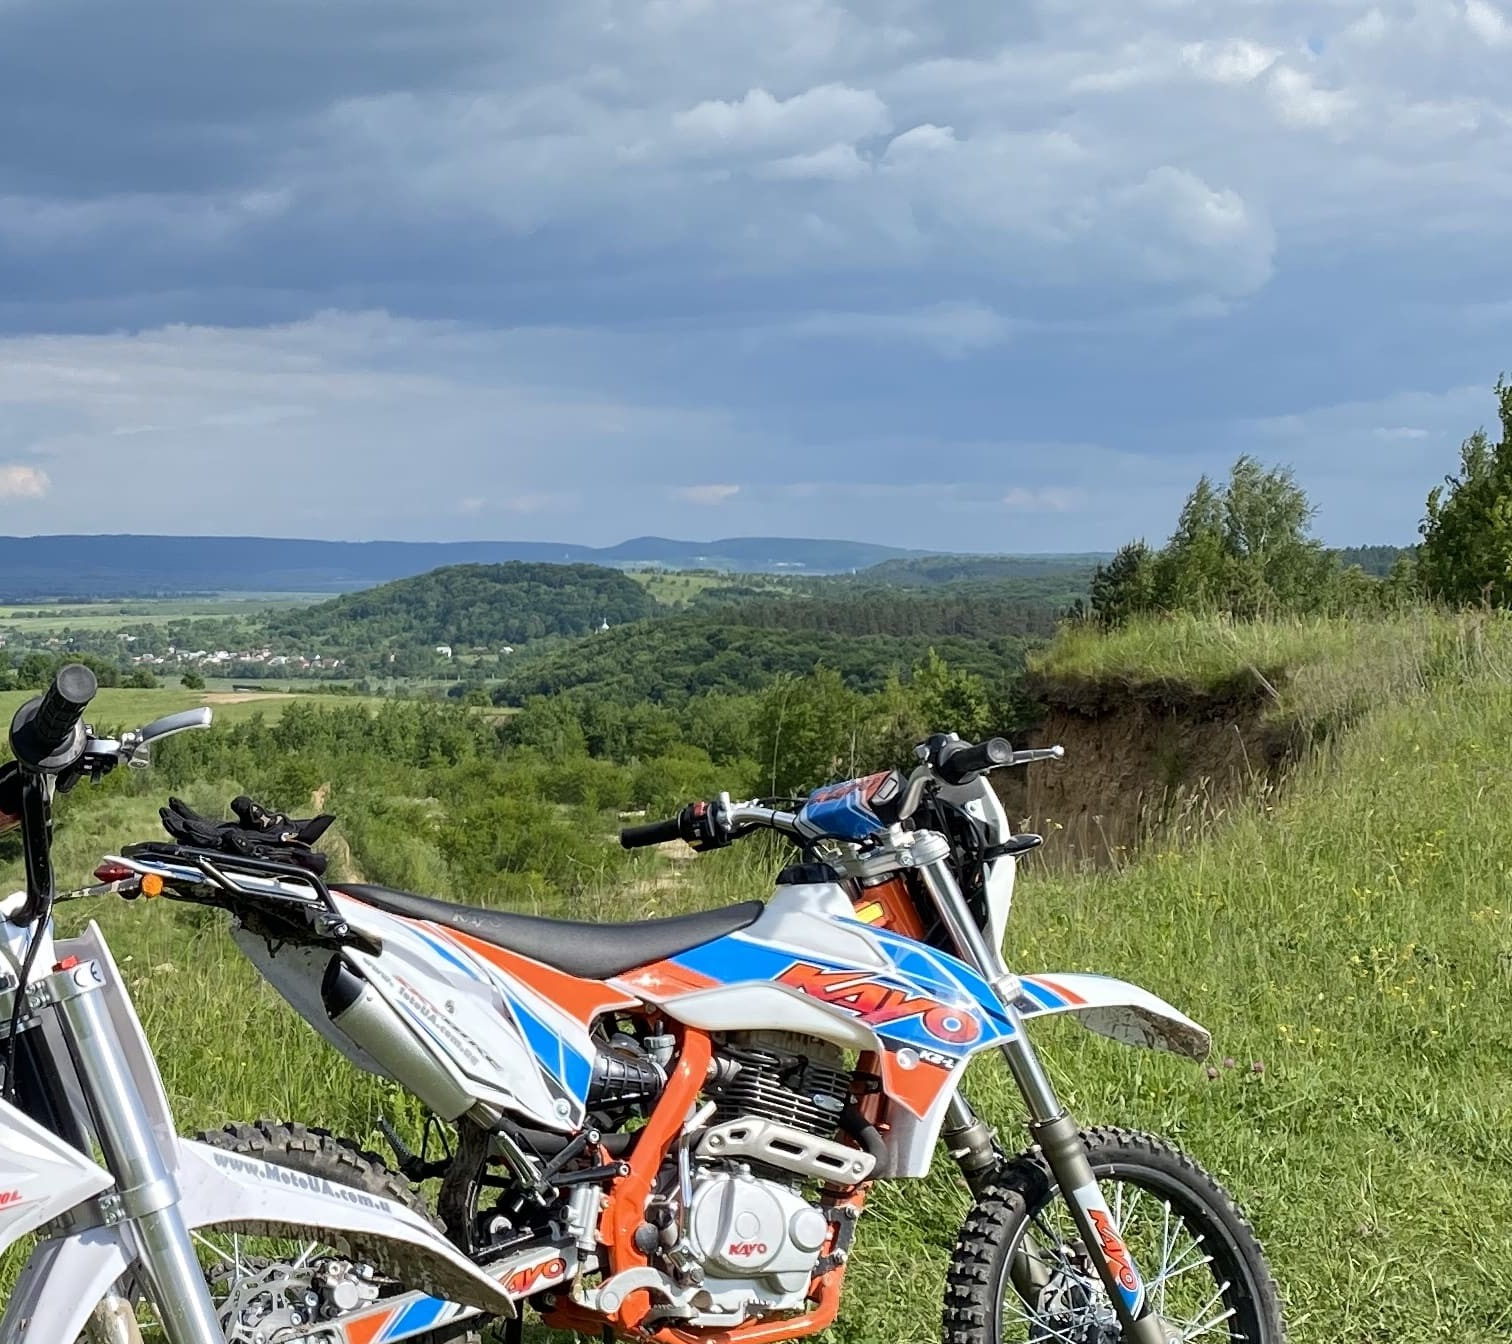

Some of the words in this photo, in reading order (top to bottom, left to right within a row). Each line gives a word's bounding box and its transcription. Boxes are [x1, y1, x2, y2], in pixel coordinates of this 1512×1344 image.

[774, 961, 980, 1044] KAYO
[728, 1241, 767, 1258] KAYO
[1087, 1208, 1139, 1291] KAYO
